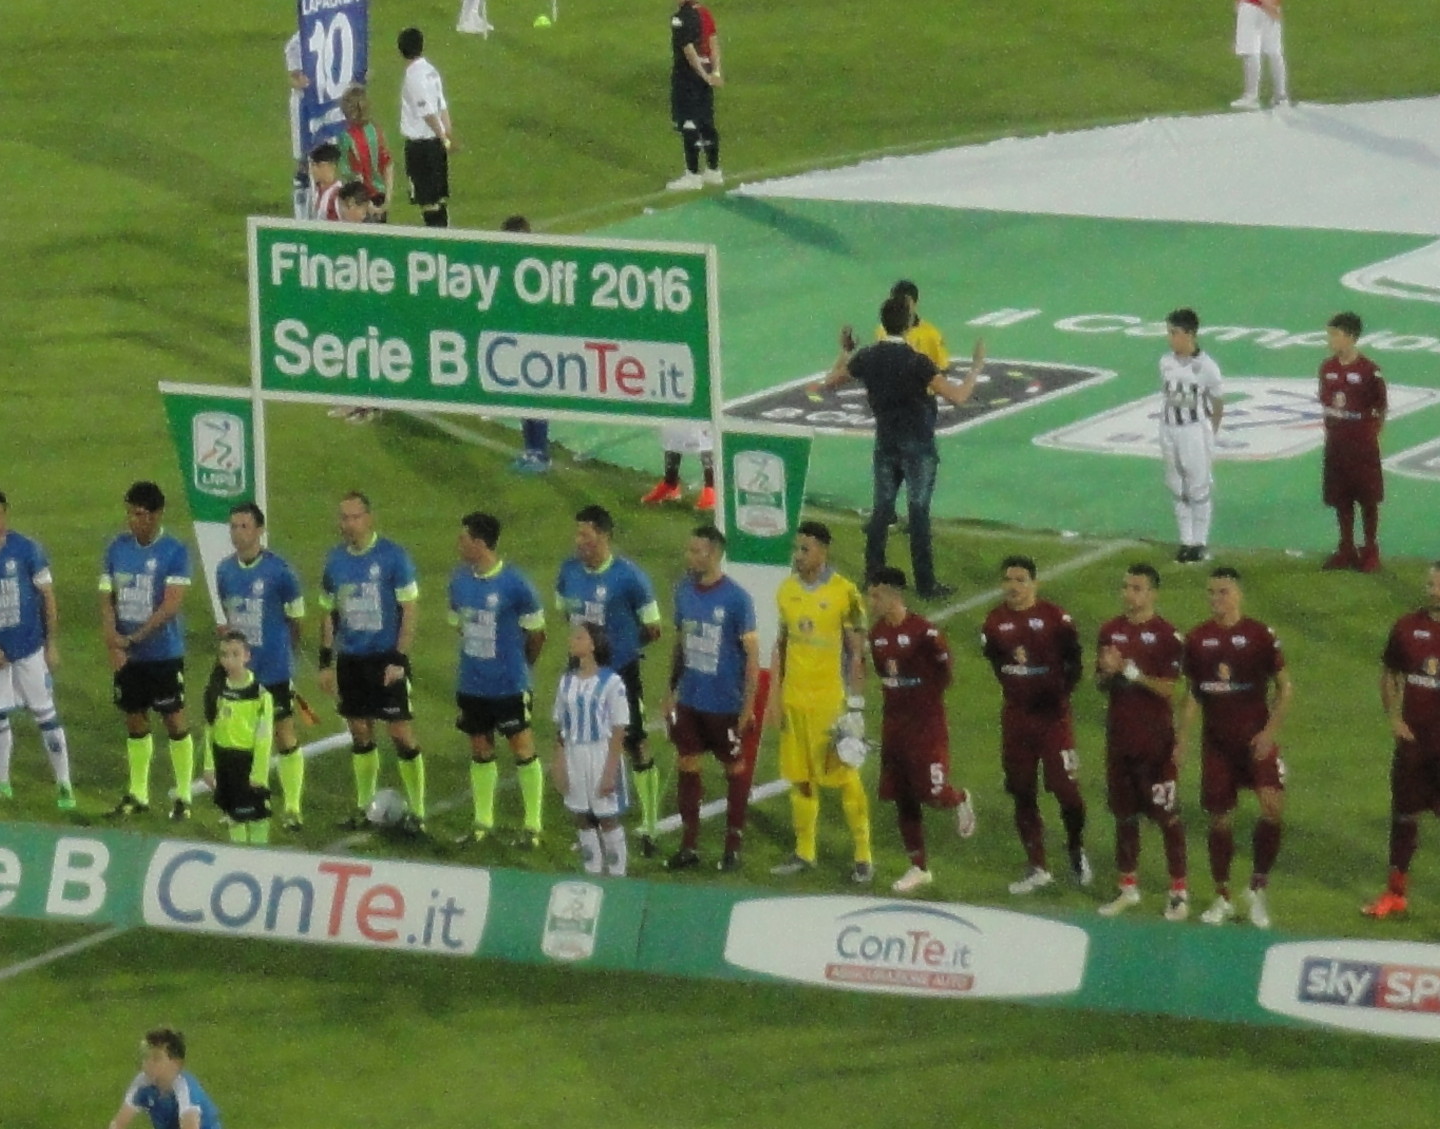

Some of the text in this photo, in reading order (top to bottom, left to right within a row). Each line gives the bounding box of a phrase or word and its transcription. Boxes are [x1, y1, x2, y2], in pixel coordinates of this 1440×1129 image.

[309, 12, 354, 105] 10
[271, 241, 692, 313] Finale Play Off 2016
[274, 317, 687, 400] Serie B ConTe.it
[45, 836, 111, 916] B
[156, 848, 467, 949] ConTe.it
[836, 924, 971, 970] ConTe.it
[1306, 960, 1371, 1005] sky
